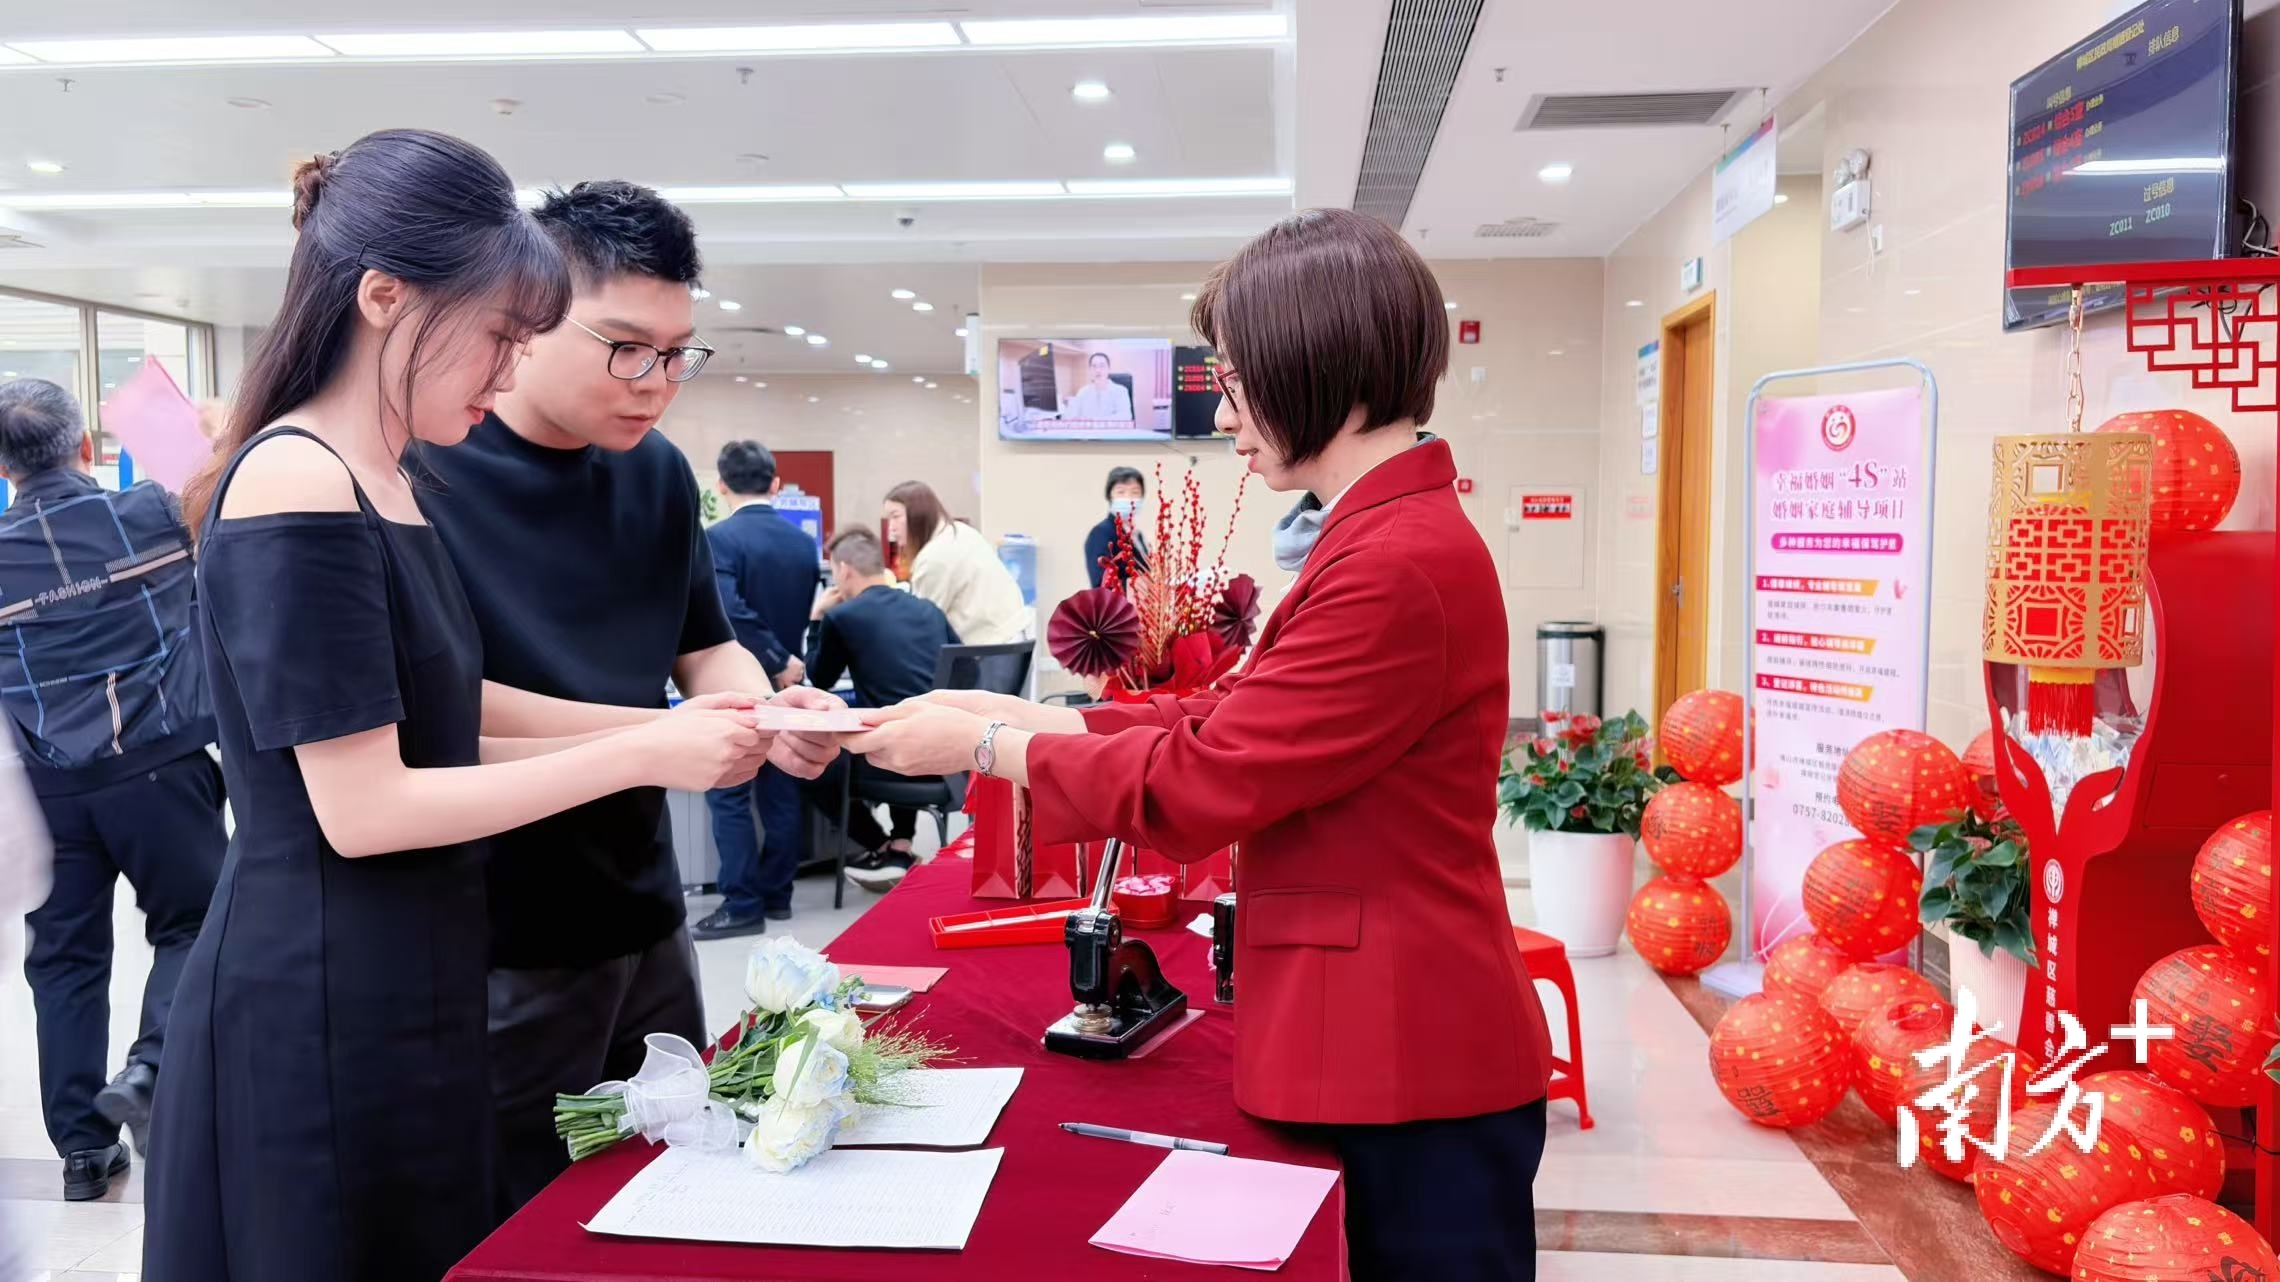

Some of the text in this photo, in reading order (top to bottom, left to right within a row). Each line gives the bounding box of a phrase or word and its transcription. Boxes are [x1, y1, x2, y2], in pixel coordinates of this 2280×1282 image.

[2148, 25, 2180, 57] 排队信息
[2143, 176, 2175, 203] 过号信息
[2145, 203, 2171, 224] ZC010
[2109, 216, 2133, 237] ZC011
[1773, 498, 1904, 520] 婚姻家庭辅导项目
[1792, 803, 1856, 828] 0757-8202
[2044, 906, 2058, 1060] 禅城区慈善会
